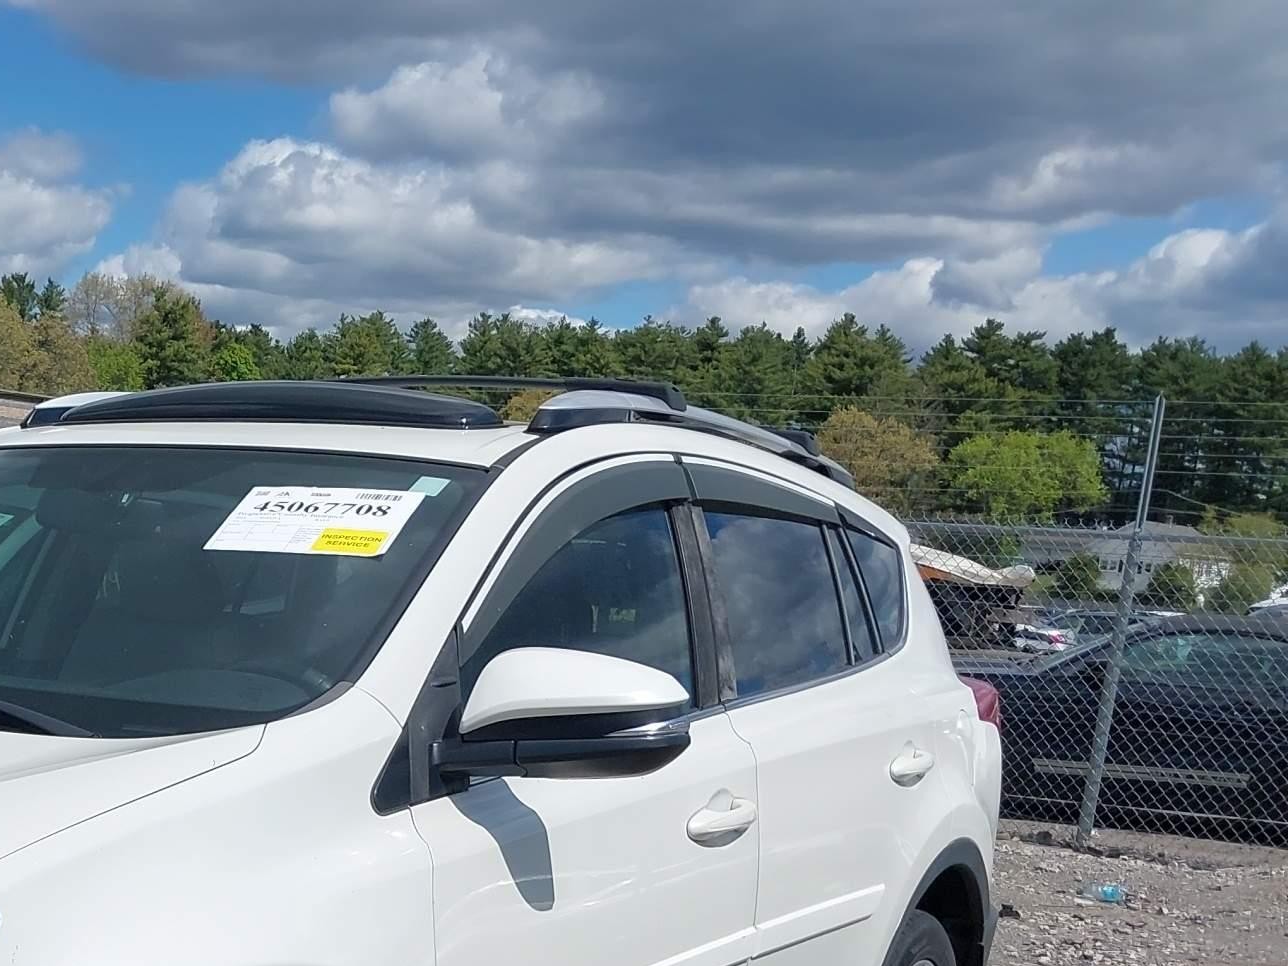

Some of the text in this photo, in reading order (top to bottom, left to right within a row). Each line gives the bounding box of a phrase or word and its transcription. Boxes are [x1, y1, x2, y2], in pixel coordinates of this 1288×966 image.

[253, 500, 392, 517] 45067708
[321, 534, 383, 544] INSPECTION
[325, 540, 371, 549] SERVICE
